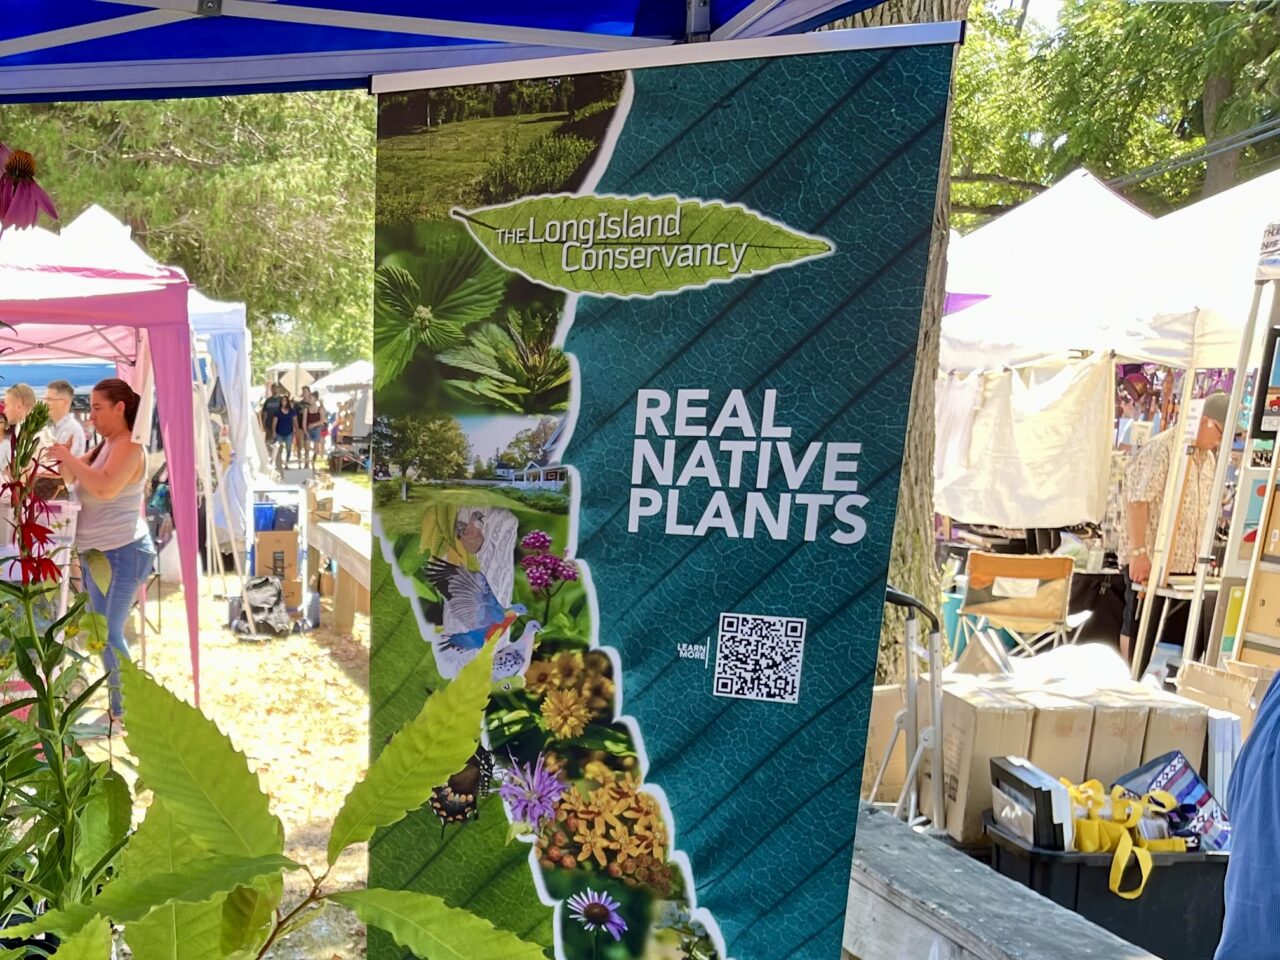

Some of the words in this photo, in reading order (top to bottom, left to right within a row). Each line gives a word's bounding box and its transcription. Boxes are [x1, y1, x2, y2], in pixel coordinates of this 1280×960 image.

[496, 227, 526, 244] THE
[528, 216, 594, 249] Long
[596, 206, 681, 240] Island
[562, 241, 748, 273] Conservancy
[634, 388, 793, 438] REAL
[631, 438, 862, 492] NATIVE
[627, 488, 870, 545] PLANTS
[677, 642, 706, 652] LEARN
[679, 650, 706, 660] MORE
